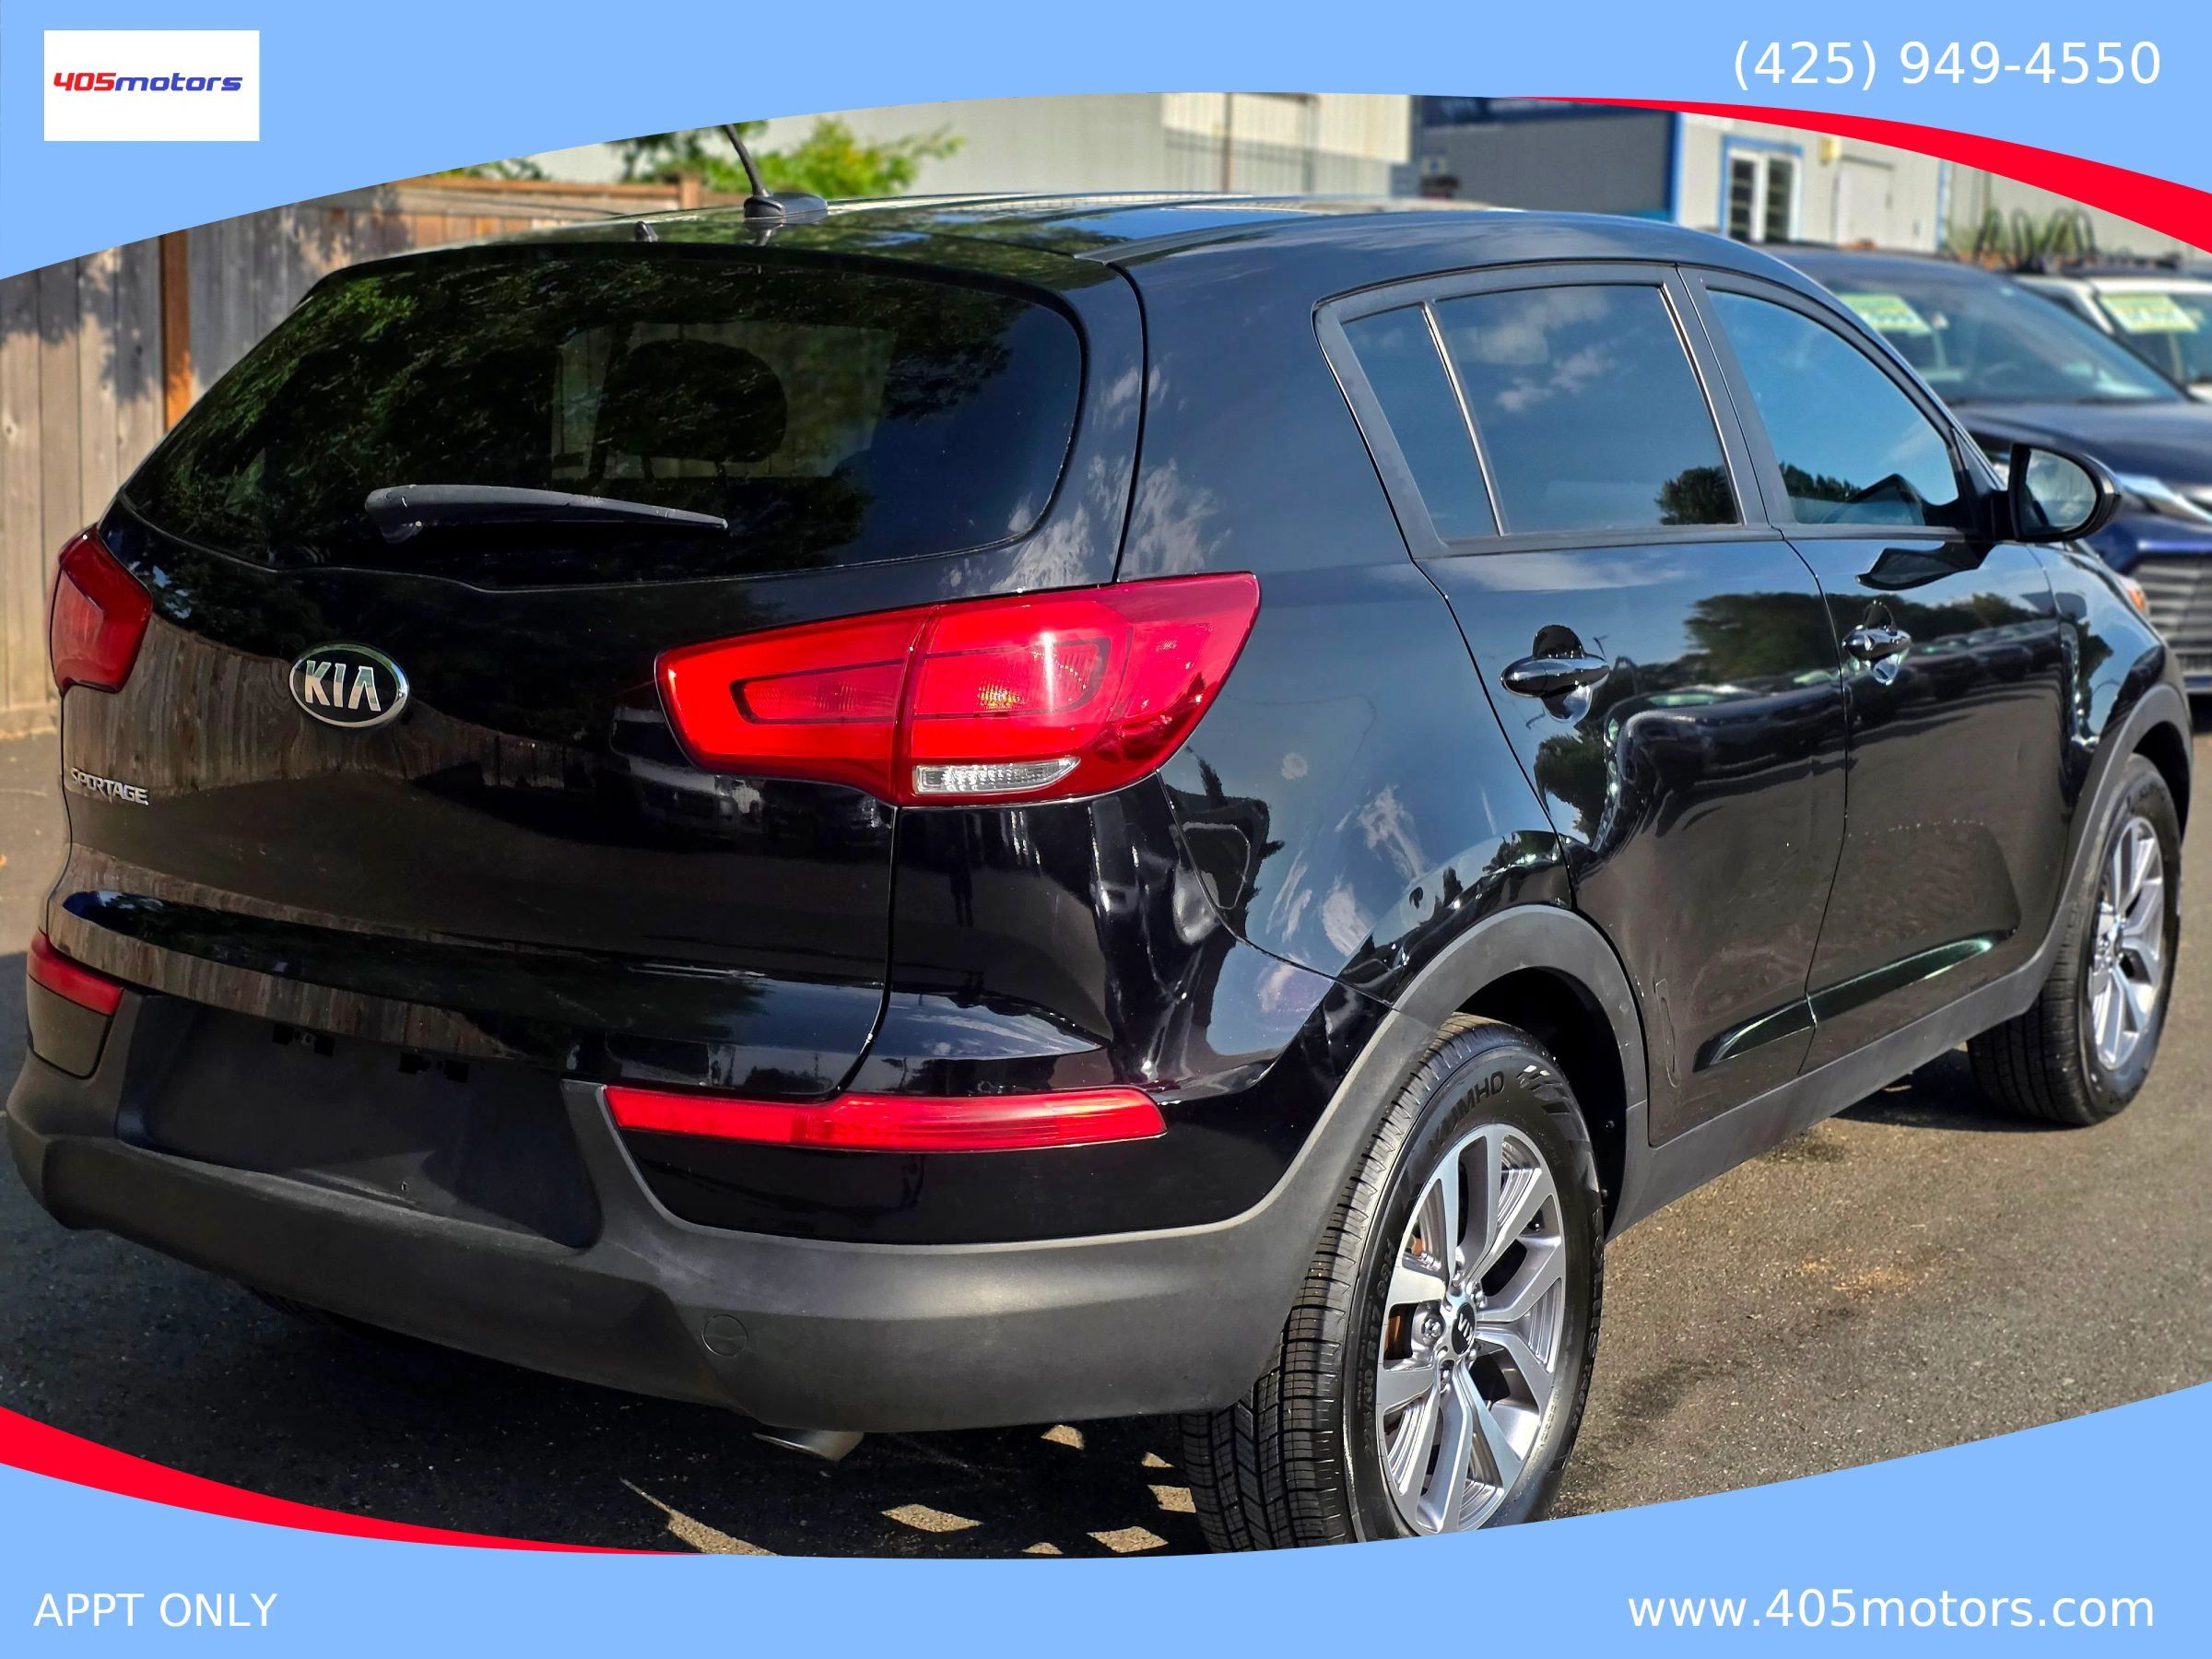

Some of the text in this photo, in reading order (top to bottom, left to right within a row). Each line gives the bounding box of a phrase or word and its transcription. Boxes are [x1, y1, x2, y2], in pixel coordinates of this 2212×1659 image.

[303, 659, 382, 712] KIA
[70, 767, 149, 806] SPORTAGE
[1429, 1070, 1505, 1153] KUMHO
